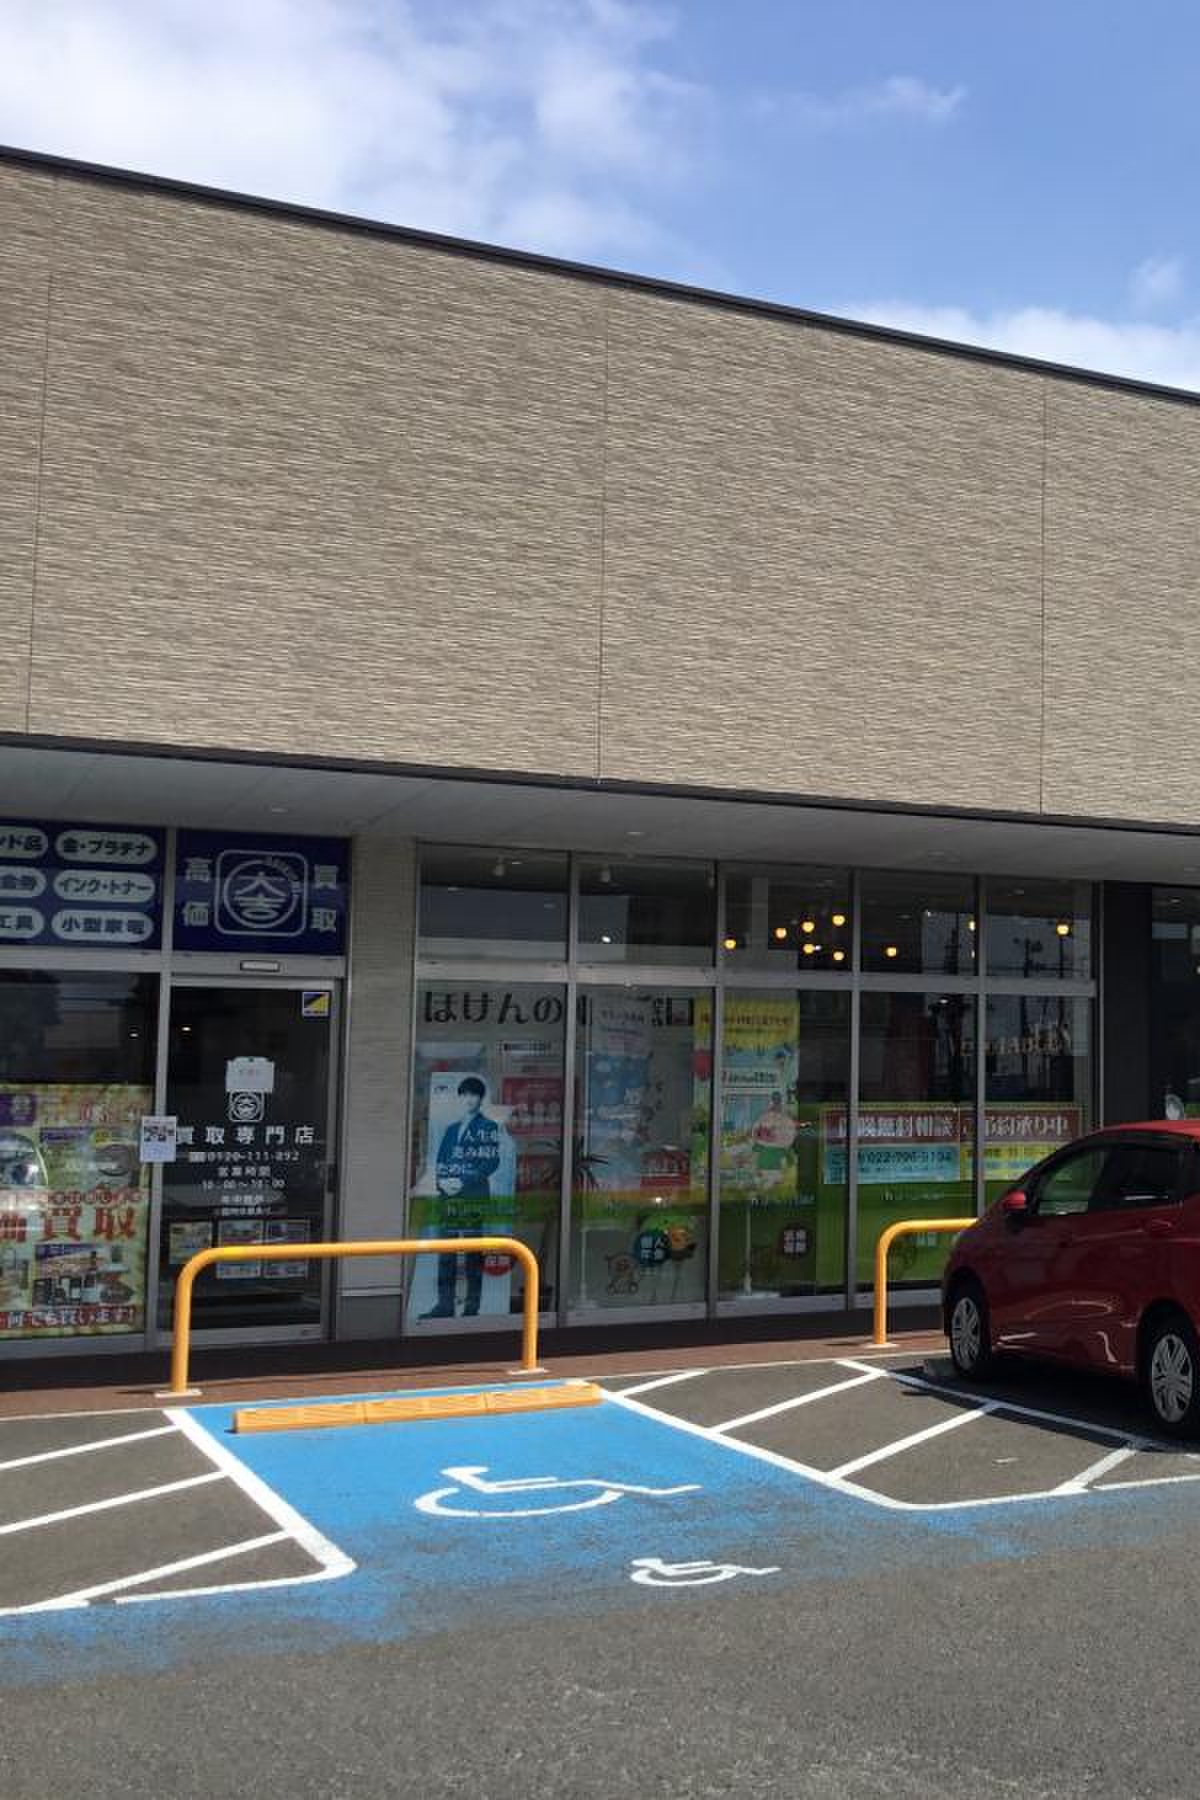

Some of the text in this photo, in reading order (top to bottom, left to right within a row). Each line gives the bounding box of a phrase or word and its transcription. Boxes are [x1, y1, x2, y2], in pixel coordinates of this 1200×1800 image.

[177, 1126, 315, 1145] 買取専門店
